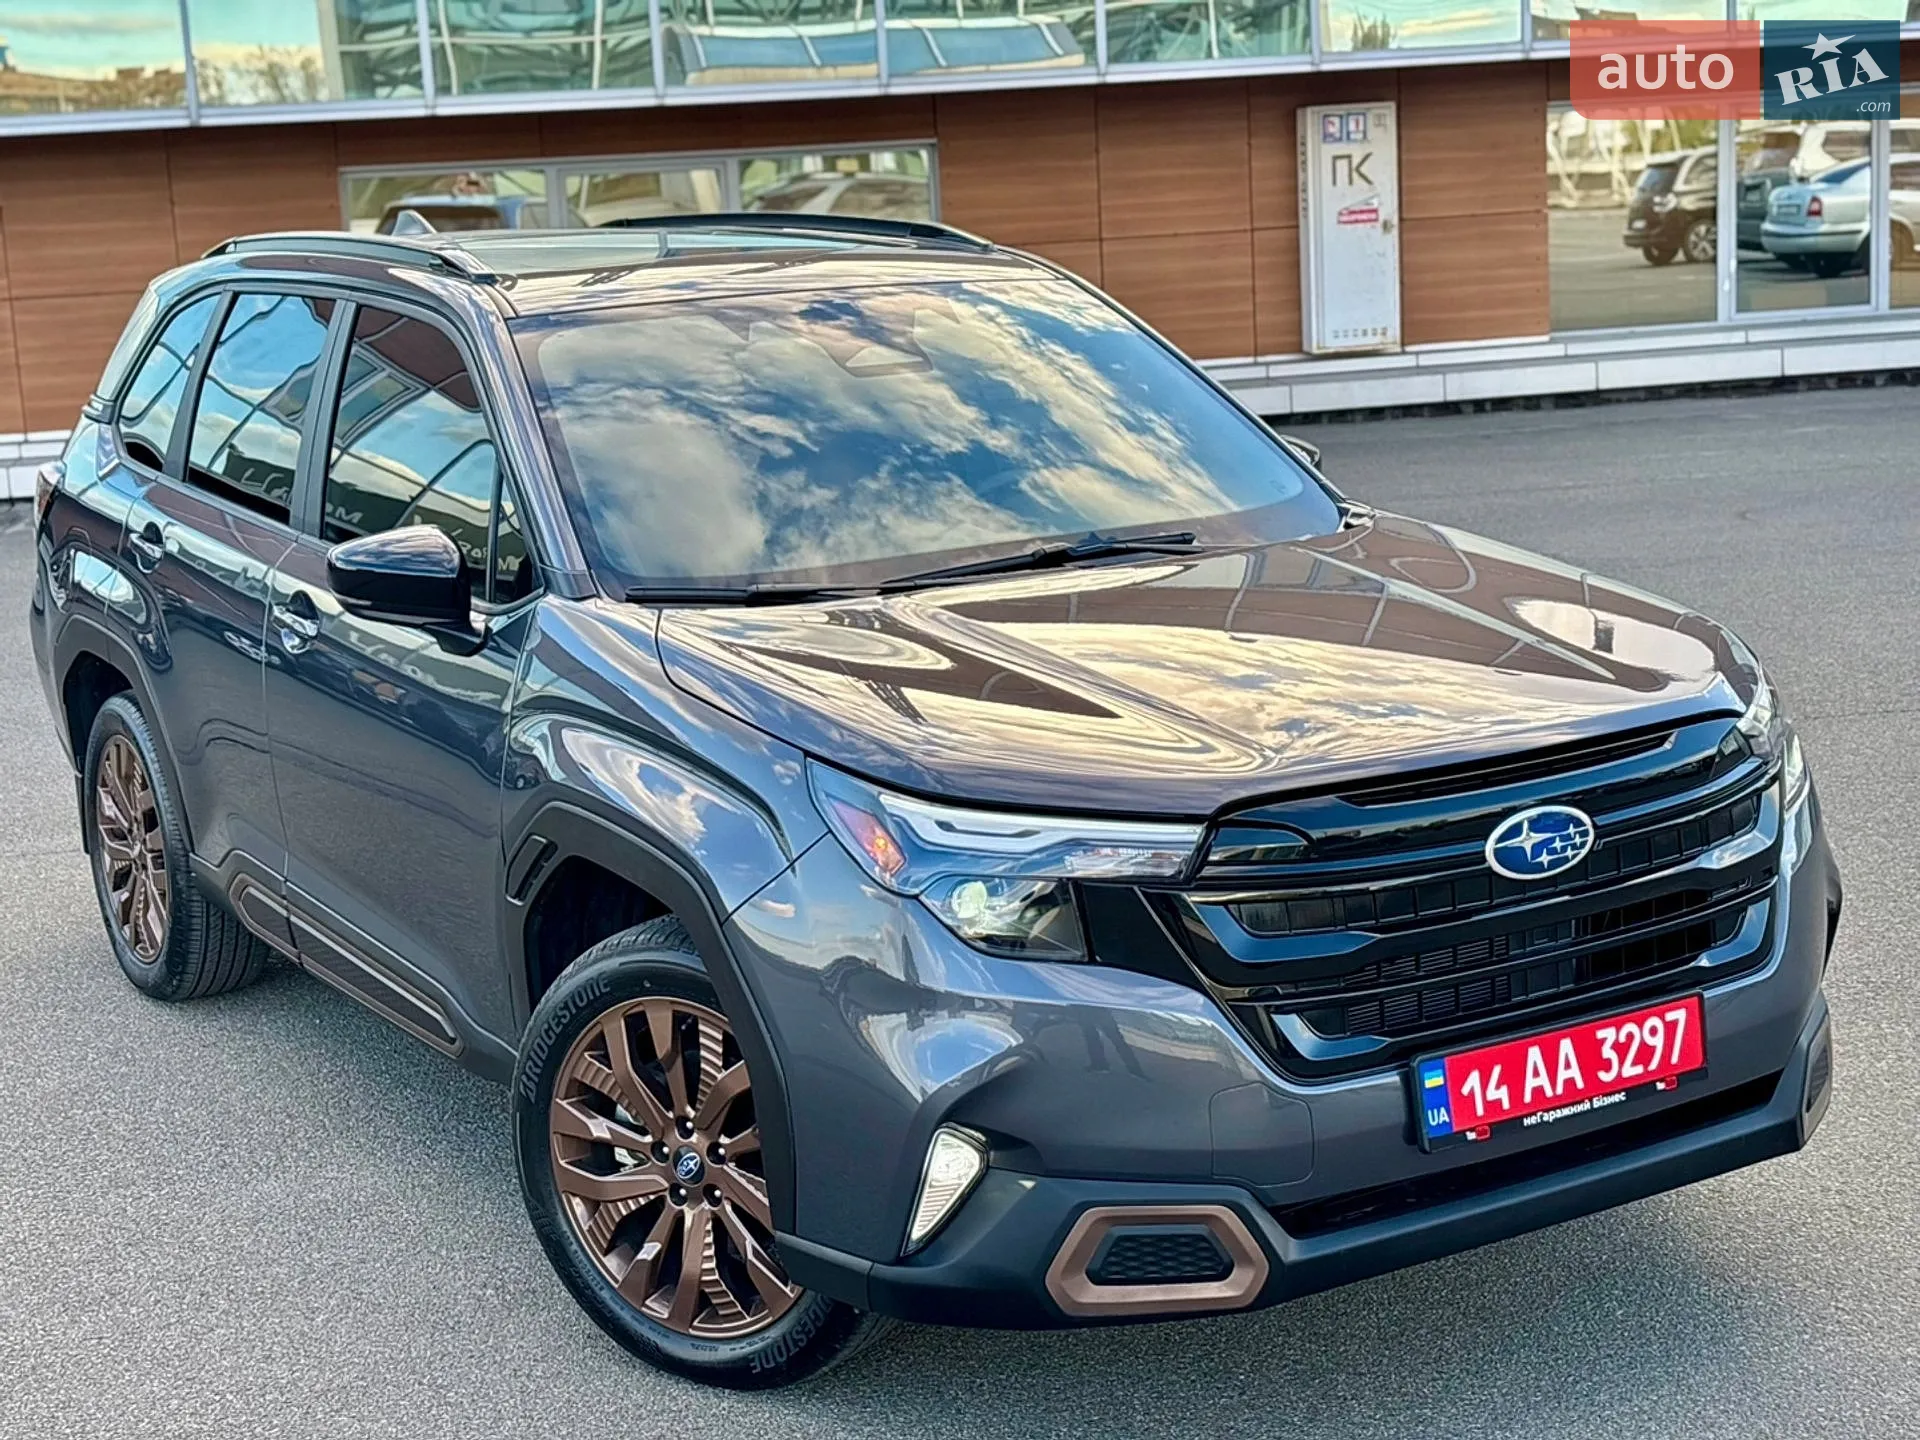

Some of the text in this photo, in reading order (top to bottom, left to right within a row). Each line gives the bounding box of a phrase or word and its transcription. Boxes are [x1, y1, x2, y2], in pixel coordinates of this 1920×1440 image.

[1332, 151, 1374, 187] ПК
[519, 971, 611, 1104] BRIDGESTONE
[1461, 1008, 1687, 1117] 14 AA 3297
[1428, 1109, 1449, 1126] UA
[1592, 1091, 1626, 1109] Бізнес
